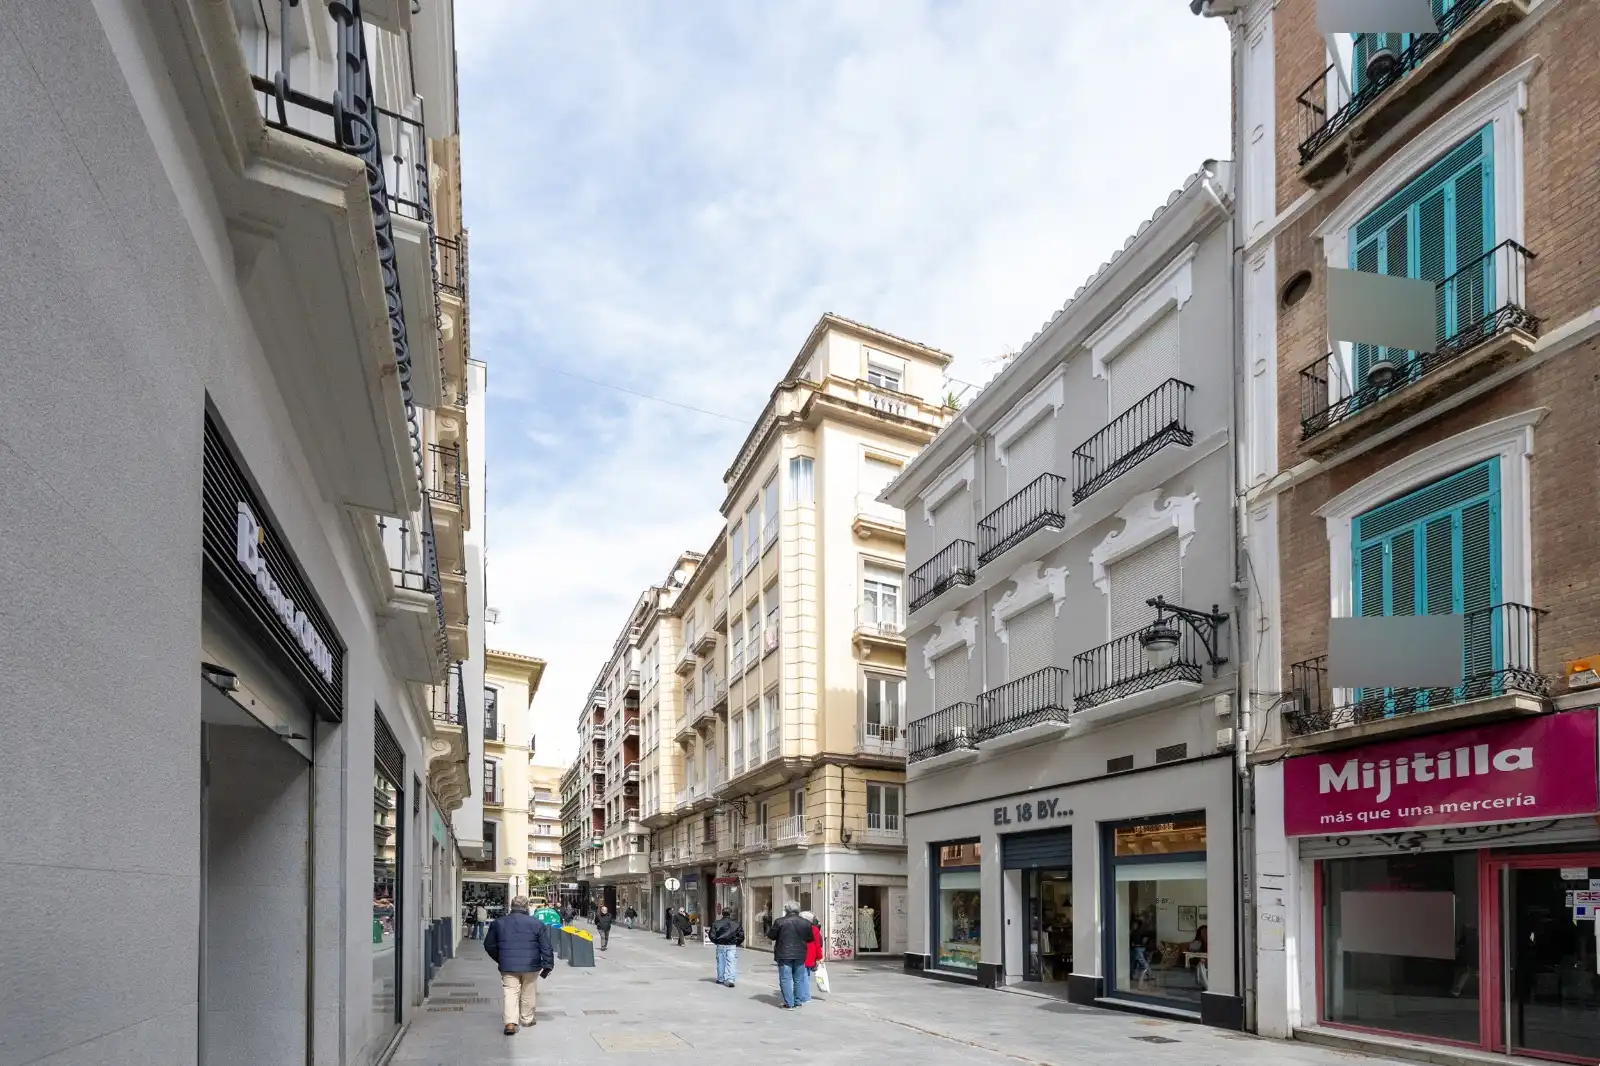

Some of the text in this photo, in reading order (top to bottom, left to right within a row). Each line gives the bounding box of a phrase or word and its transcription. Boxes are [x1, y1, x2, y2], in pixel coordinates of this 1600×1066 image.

[1319, 744, 1534, 803] Mijitilla
[994, 798, 1074, 826] EL 18 BY...
[1320, 793, 1536, 824] más que una mercería
